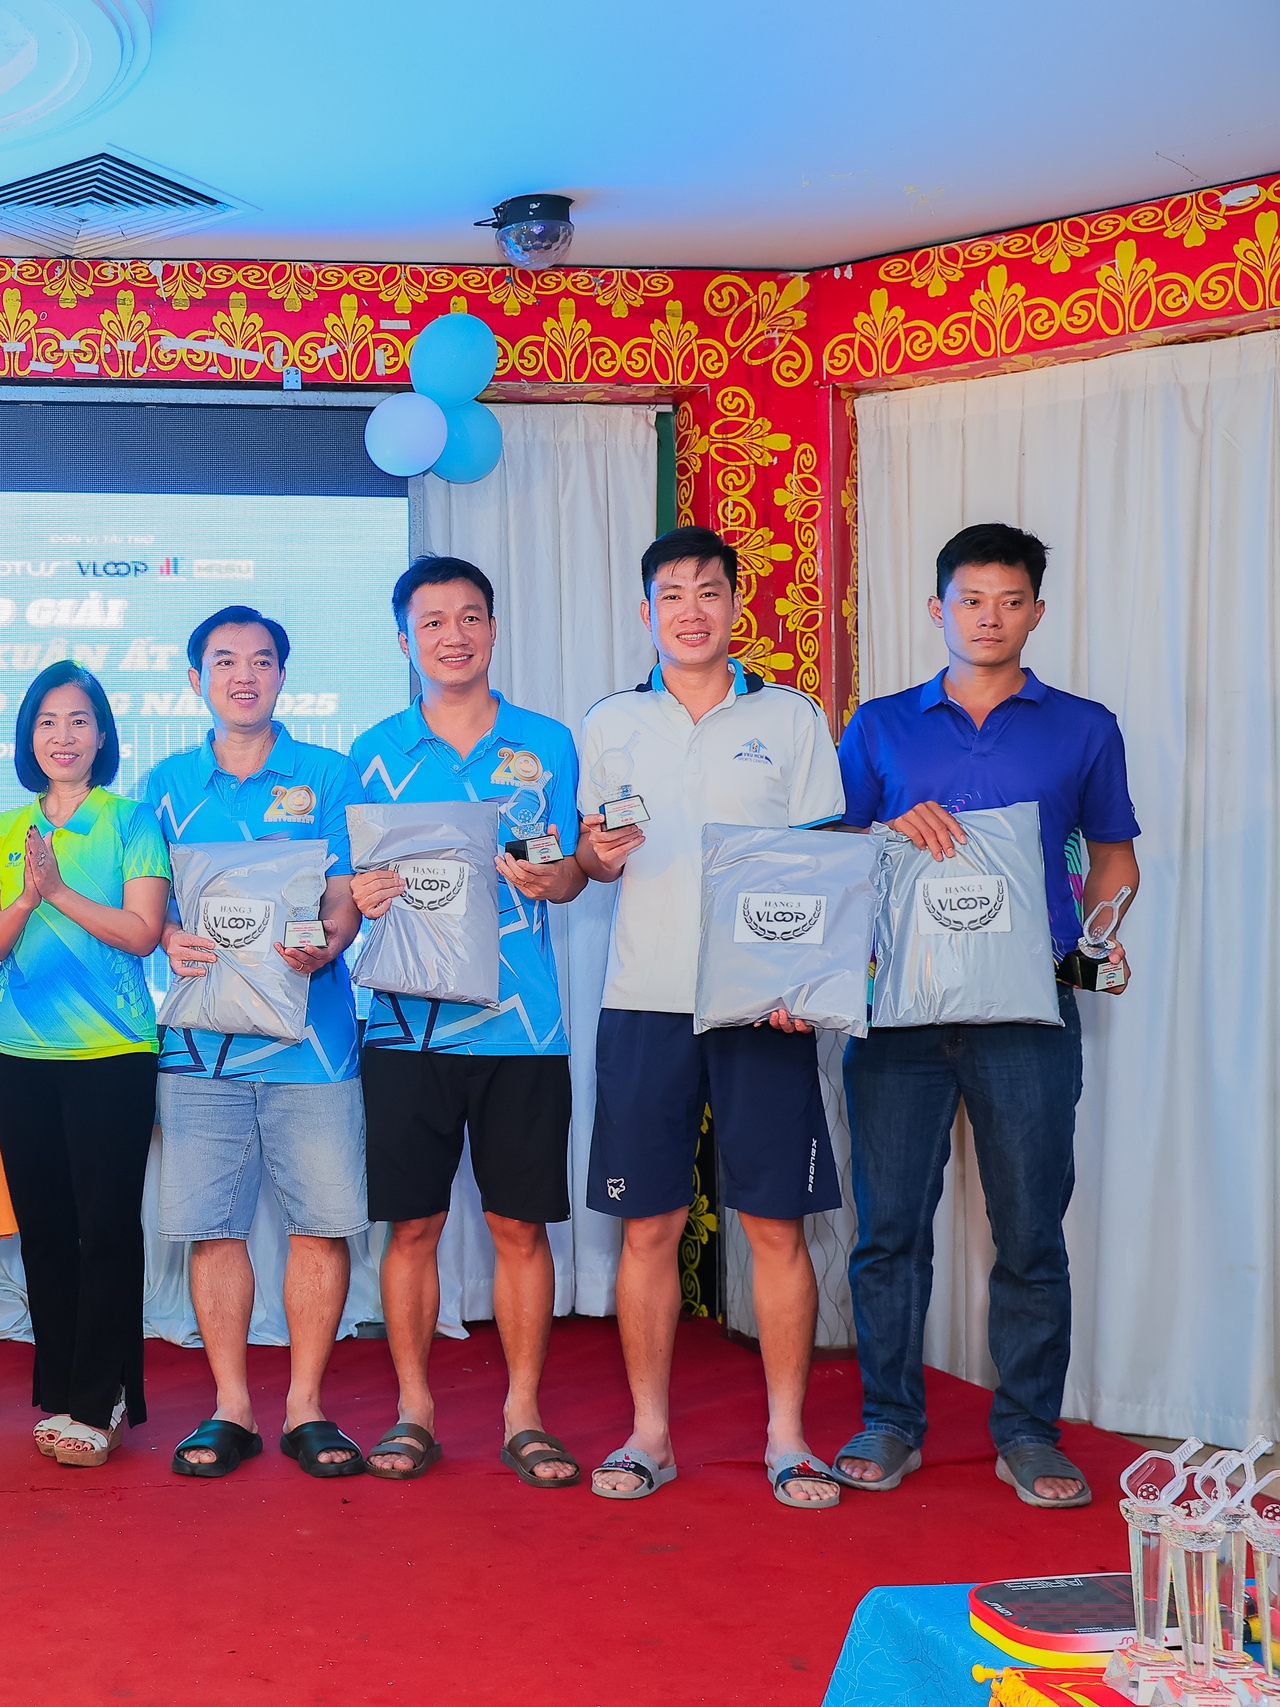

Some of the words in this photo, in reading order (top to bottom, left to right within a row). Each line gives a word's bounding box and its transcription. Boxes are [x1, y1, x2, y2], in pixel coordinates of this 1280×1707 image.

[76, 557, 150, 578] VLOOP
[24, 590, 129, 630] GIẢI
[412, 866, 439, 876] HẠNG
[405, 877, 451, 892] VLOOP
[944, 884, 975, 895] HẠNG
[977, 884, 983, 892] 3
[220, 905, 246, 914] HẠNG
[764, 900, 793, 909] HẠNG
[796, 901, 801, 909] 3
[937, 896, 990, 912] VLOOP
[213, 916, 256, 930] VLOOP
[756, 910, 807, 923] VLOOP
[983, 1600, 1013, 1618] LOTUS
